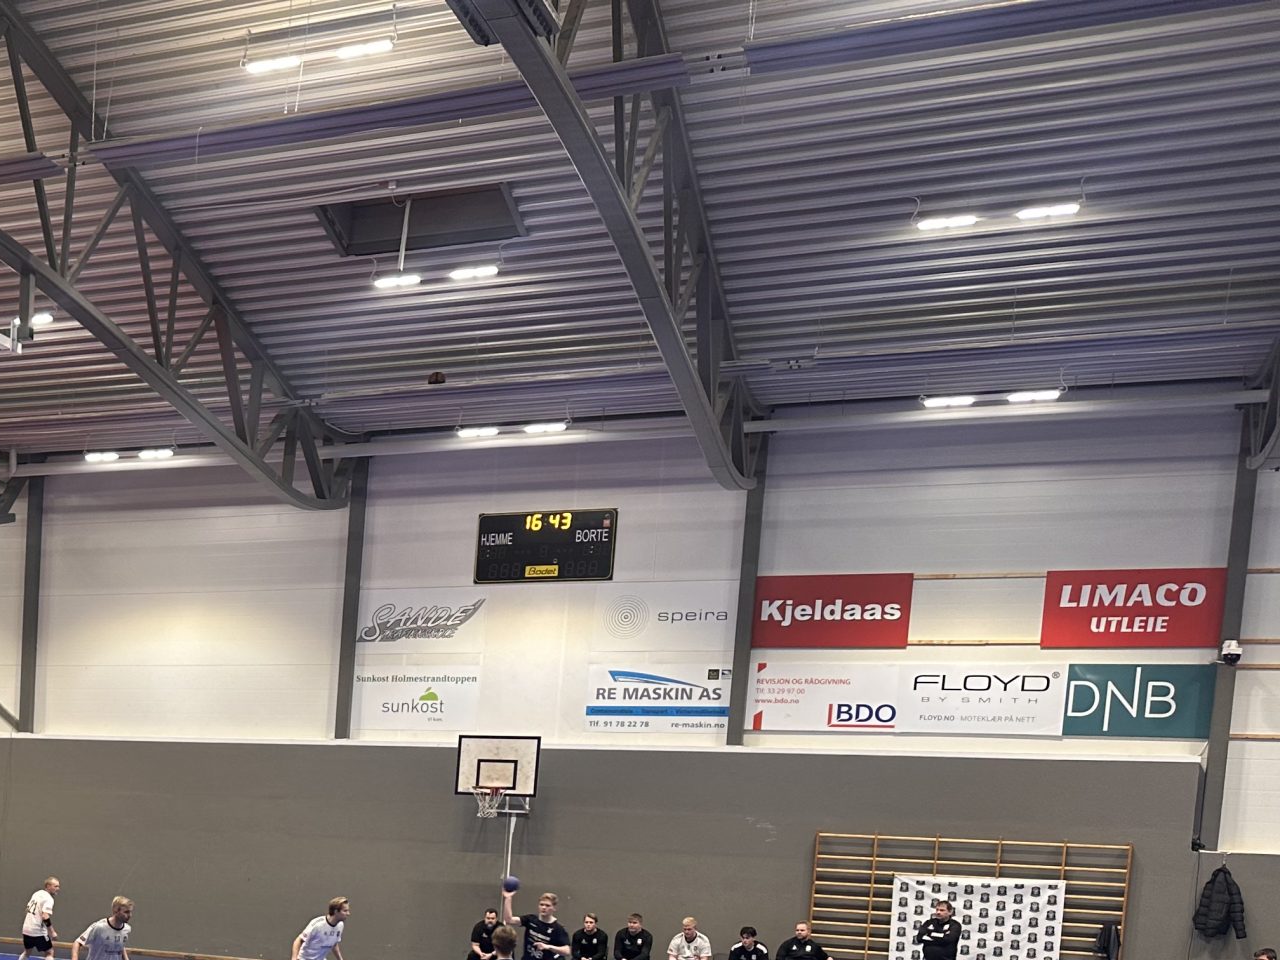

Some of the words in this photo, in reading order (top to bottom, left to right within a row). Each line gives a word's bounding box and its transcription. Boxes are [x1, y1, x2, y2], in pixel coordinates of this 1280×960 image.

[481, 532, 513, 546] HJEMME
[575, 529, 609, 543] BORTE
[1059, 582, 1207, 608] LIMACO
[657, 609, 728, 624] speira
[760, 599, 902, 627] Kjeldaas
[361, 603, 475, 640] SANDE
[1090, 616, 1170, 633] UTLEIE
[356, 674, 389, 683] Sunkost
[391, 674, 478, 685] Holmestrandtoppen
[804, 677, 851, 685] RÅDGIVNING
[913, 674, 1051, 692] FLOYD
[596, 687, 617, 700] RE
[622, 687, 693, 701] MASKIN
[698, 687, 722, 701] AS
[961, 696, 1038, 704] SMITH
[1067, 666, 1177, 732] DNB
[381, 698, 445, 714] sunkost
[836, 703, 897, 723] BDO
[603, 720, 613, 728] 91
[615, 720, 625, 728] 78
[627, 720, 637, 728] 22
[640, 720, 650, 728] 78
[670, 720, 726, 729] re-maskin.no
[1004, 714, 1014, 723] PÅ
